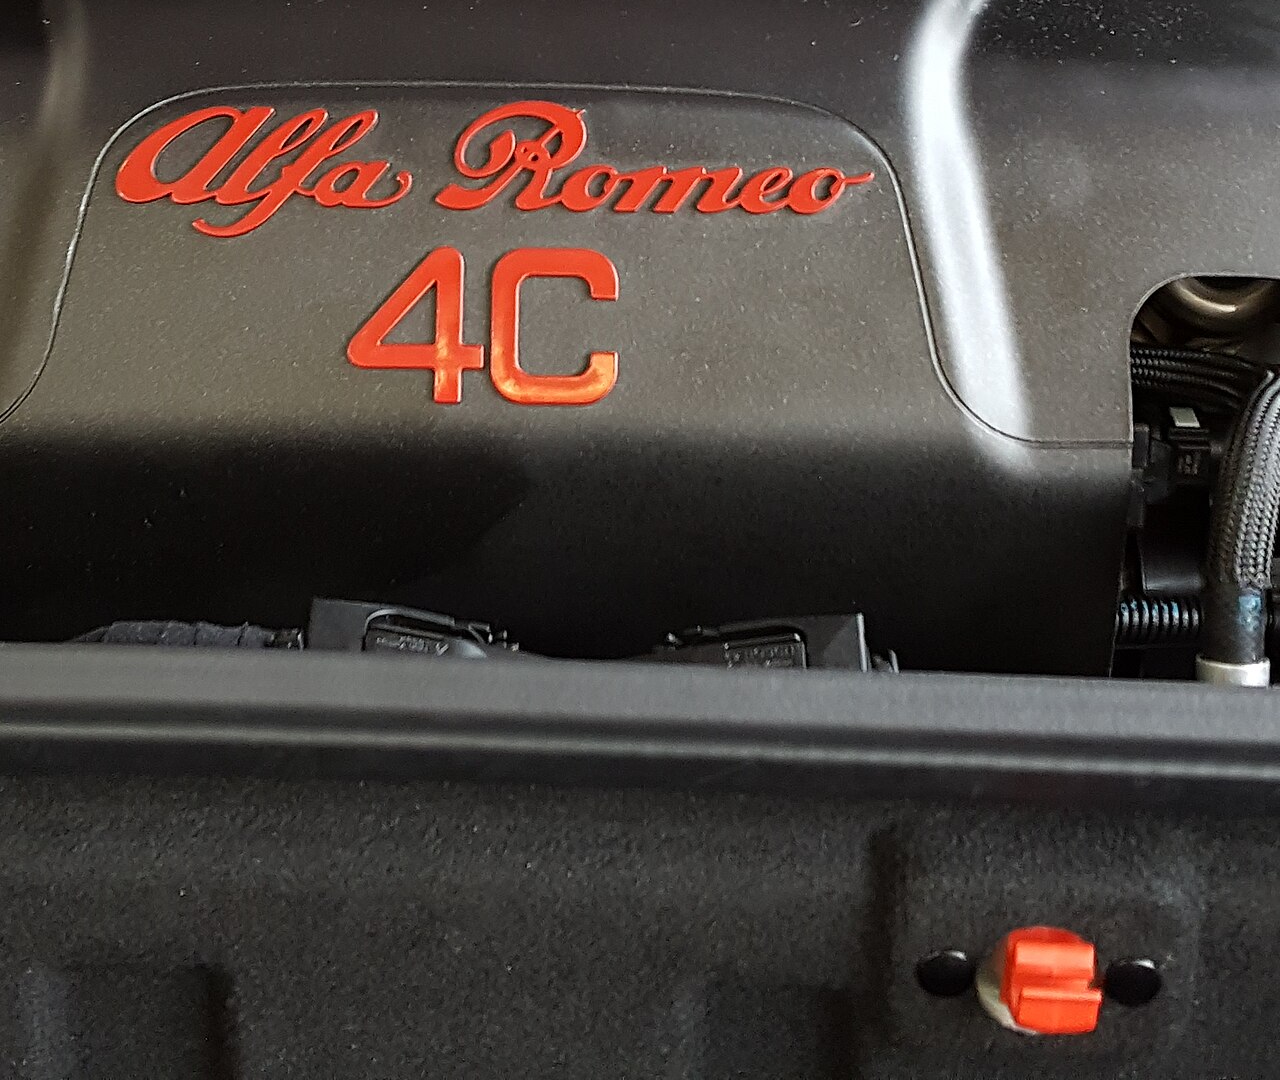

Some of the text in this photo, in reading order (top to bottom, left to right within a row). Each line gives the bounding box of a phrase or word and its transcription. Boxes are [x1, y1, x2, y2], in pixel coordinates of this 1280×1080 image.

[116, 100, 871, 237] Alfa Romeo
[346, 246, 617, 406] 4C
